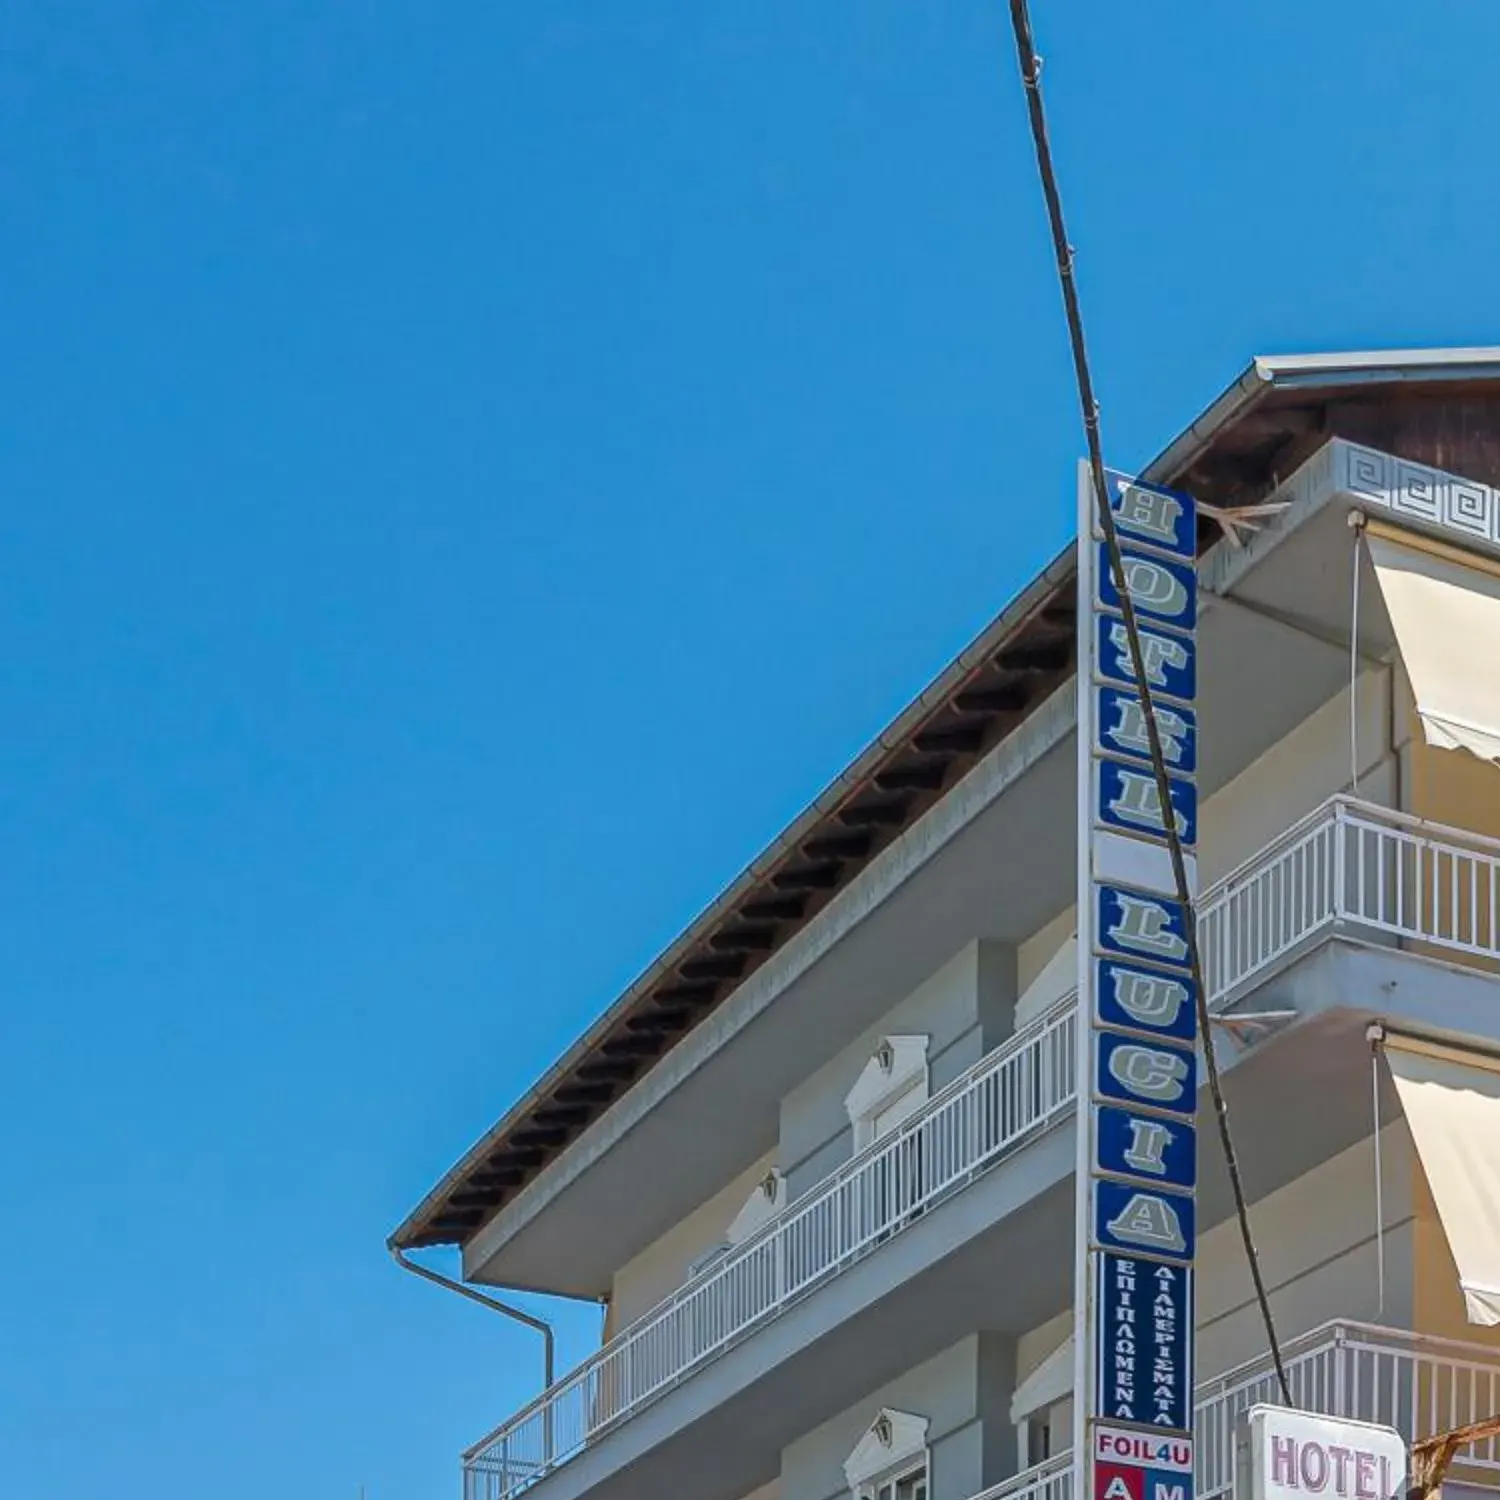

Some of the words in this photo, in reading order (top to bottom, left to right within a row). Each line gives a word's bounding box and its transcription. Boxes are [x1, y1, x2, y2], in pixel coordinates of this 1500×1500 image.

[1106, 481, 1190, 837] HOTEL
[1107, 892, 1189, 1252] LUCIA
[1099, 1434, 1190, 1465] FOIL4U
